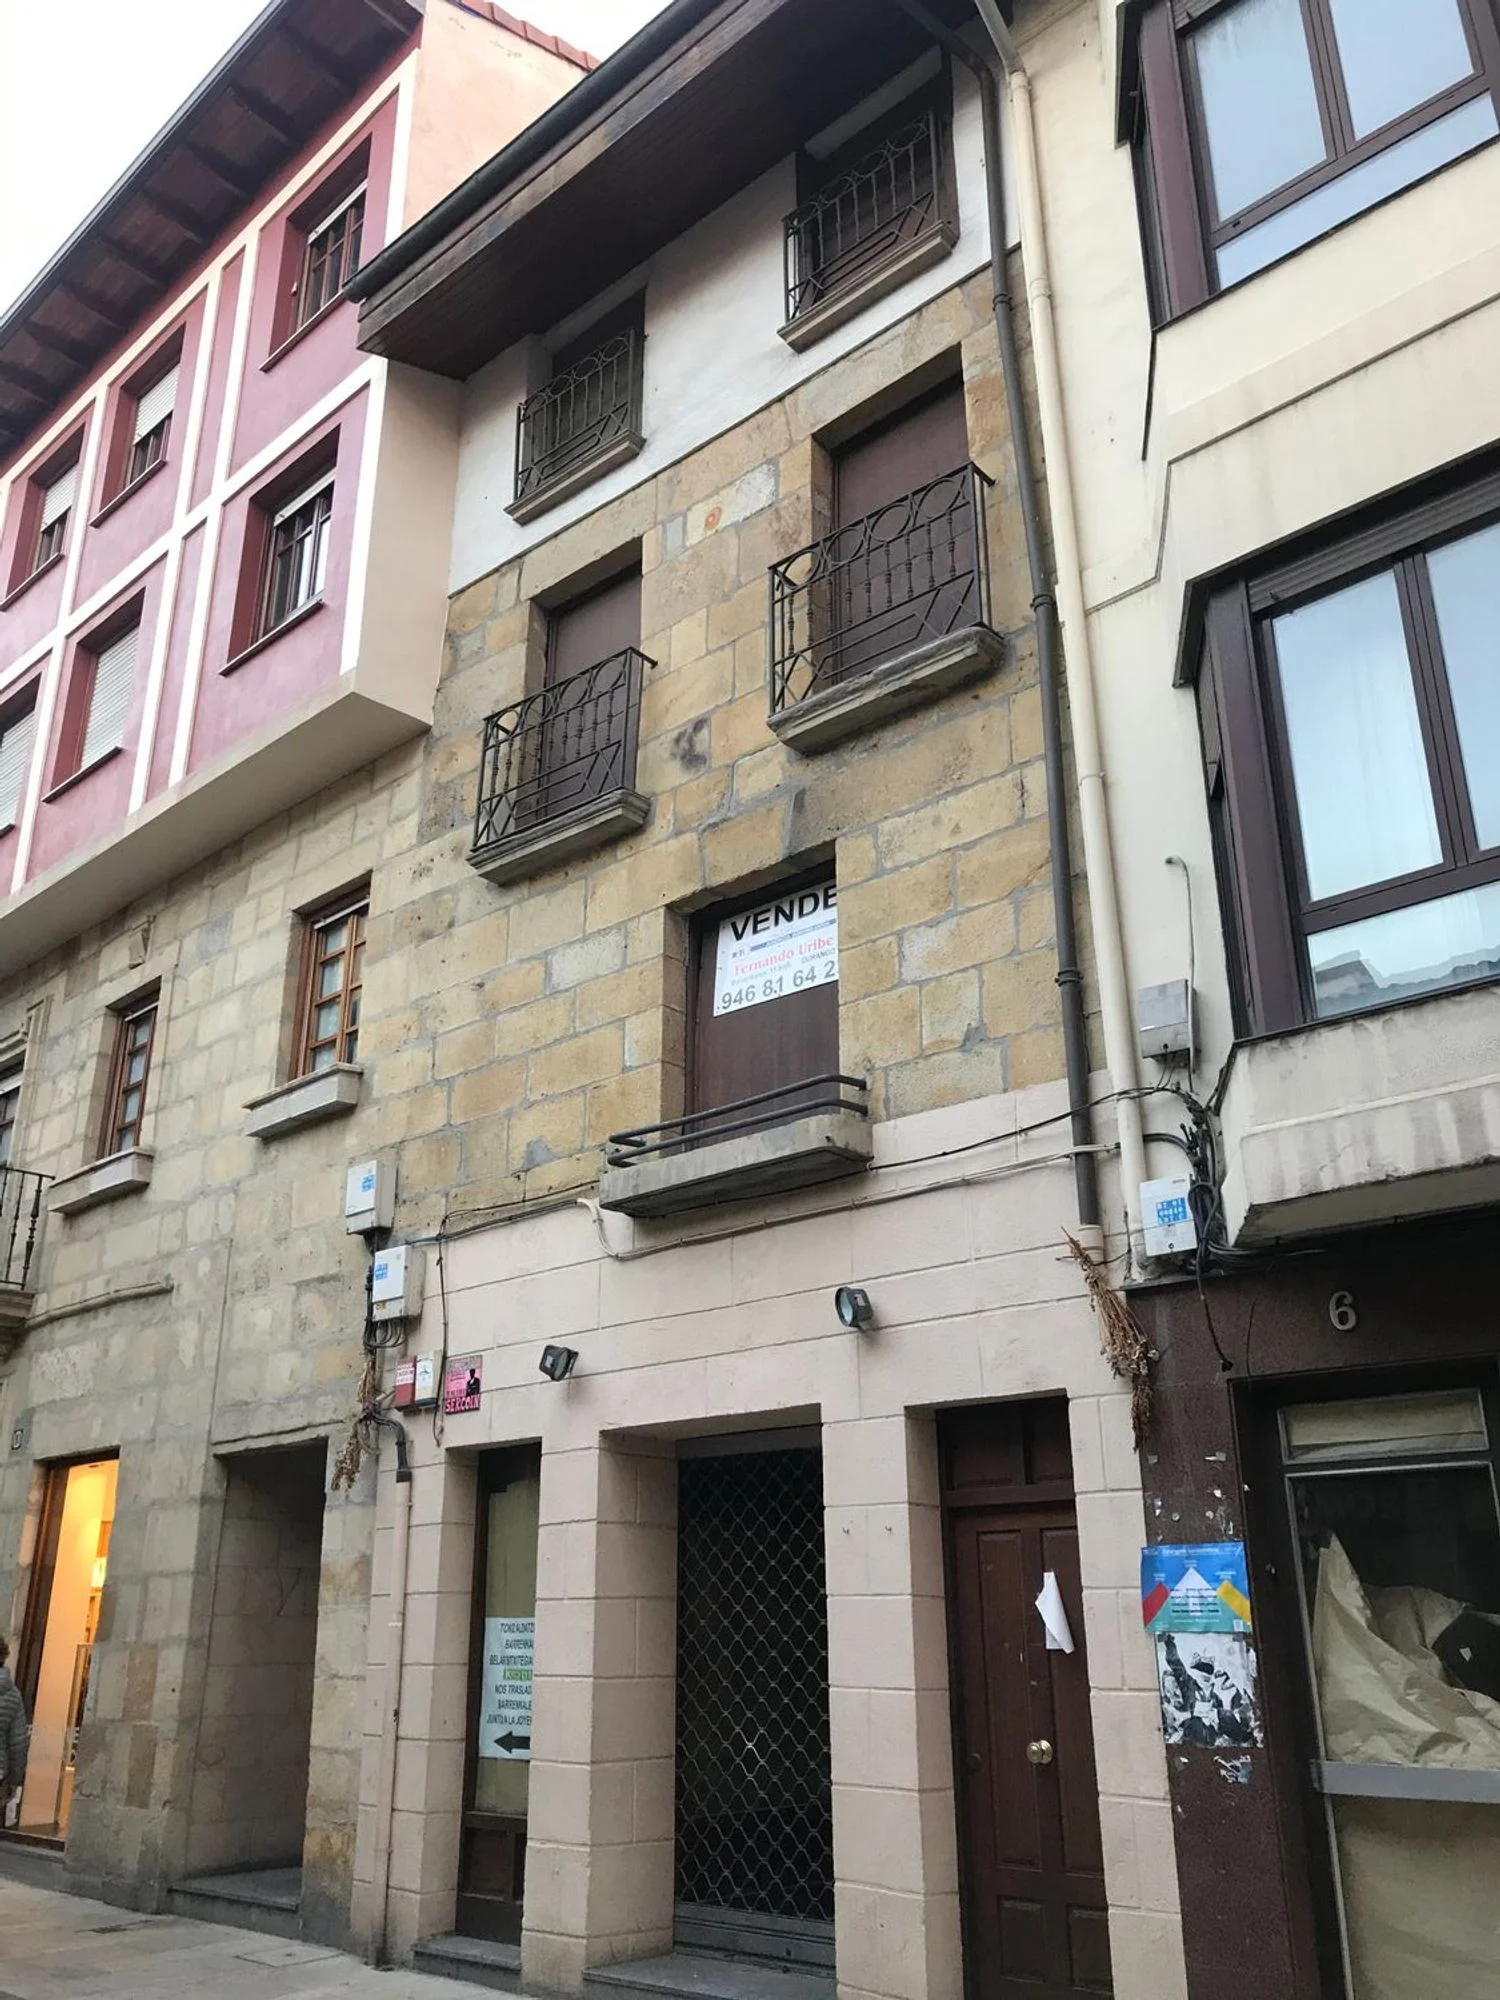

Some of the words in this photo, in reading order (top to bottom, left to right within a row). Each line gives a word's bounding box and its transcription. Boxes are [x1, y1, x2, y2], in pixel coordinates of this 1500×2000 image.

[733, 949, 794, 976] Fernando
[798, 937, 834, 957] Uribe
[721, 984, 756, 1010] 946
[793, 965, 817, 987] 64
[824, 960, 836, 979] 2
[1328, 1290, 1358, 1331] 6
